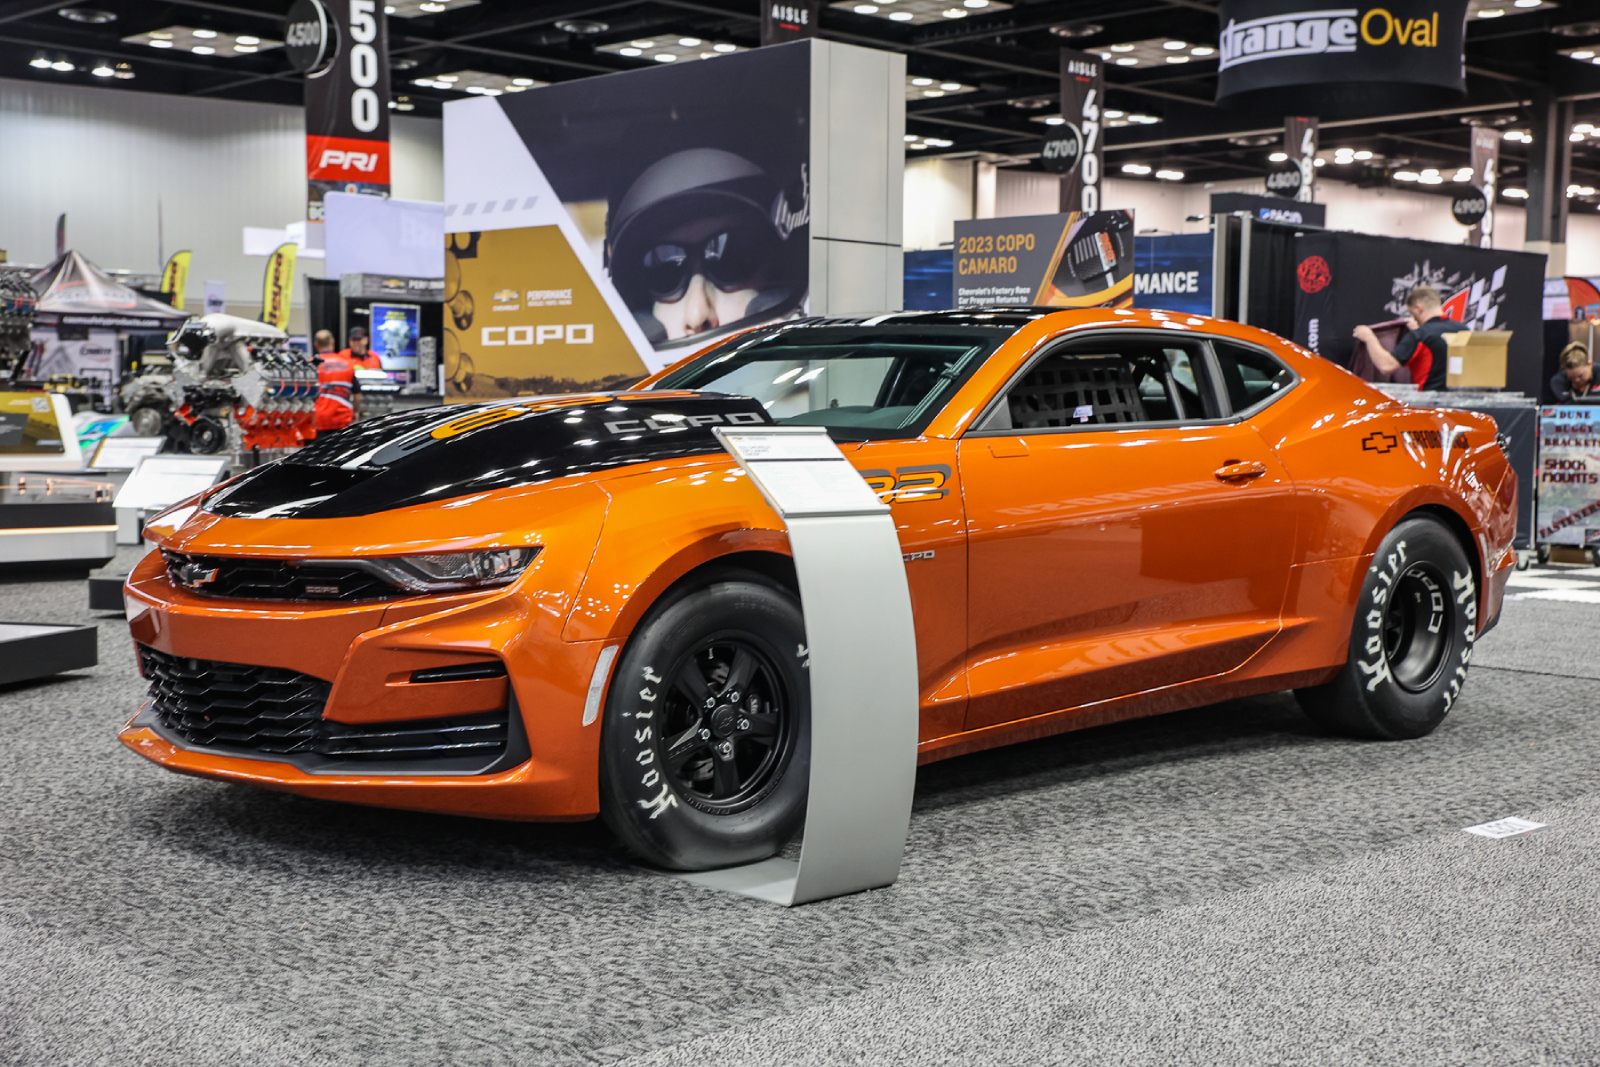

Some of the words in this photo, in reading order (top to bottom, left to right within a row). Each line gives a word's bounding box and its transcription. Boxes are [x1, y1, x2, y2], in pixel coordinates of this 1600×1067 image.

[772, 4, 809, 25] AISLE
[286, 21, 321, 47] 4500
[1360, 8, 1439, 47] Oval
[1068, 60, 1097, 77] AISLE
[1043, 138, 1077, 159] 4700
[1081, 88, 1100, 215] 4700
[318, 149, 379, 172] PRI
[1266, 171, 1301, 189] 4800
[1454, 199, 1486, 214] 4900
[959, 236, 993, 253] 2023
[996, 234, 1035, 252] COPO
[959, 257, 1017, 275] CAMARO
[991, 286, 1015, 296] Factory
[1134, 270, 1200, 294] MANCE
[481, 323, 594, 346] COPO
[603, 412, 766, 435] COPO
[1559, 410, 1591, 419] DUNE
[1554, 425, 1593, 434] BUGGY
[1544, 458, 1586, 471] SHOCK
[1542, 472, 1598, 484] MOUNTS
[1406, 569, 1444, 634] COPO
[1358, 540, 1407, 692] Hoosier
[621, 665, 679, 819] Hoosier
